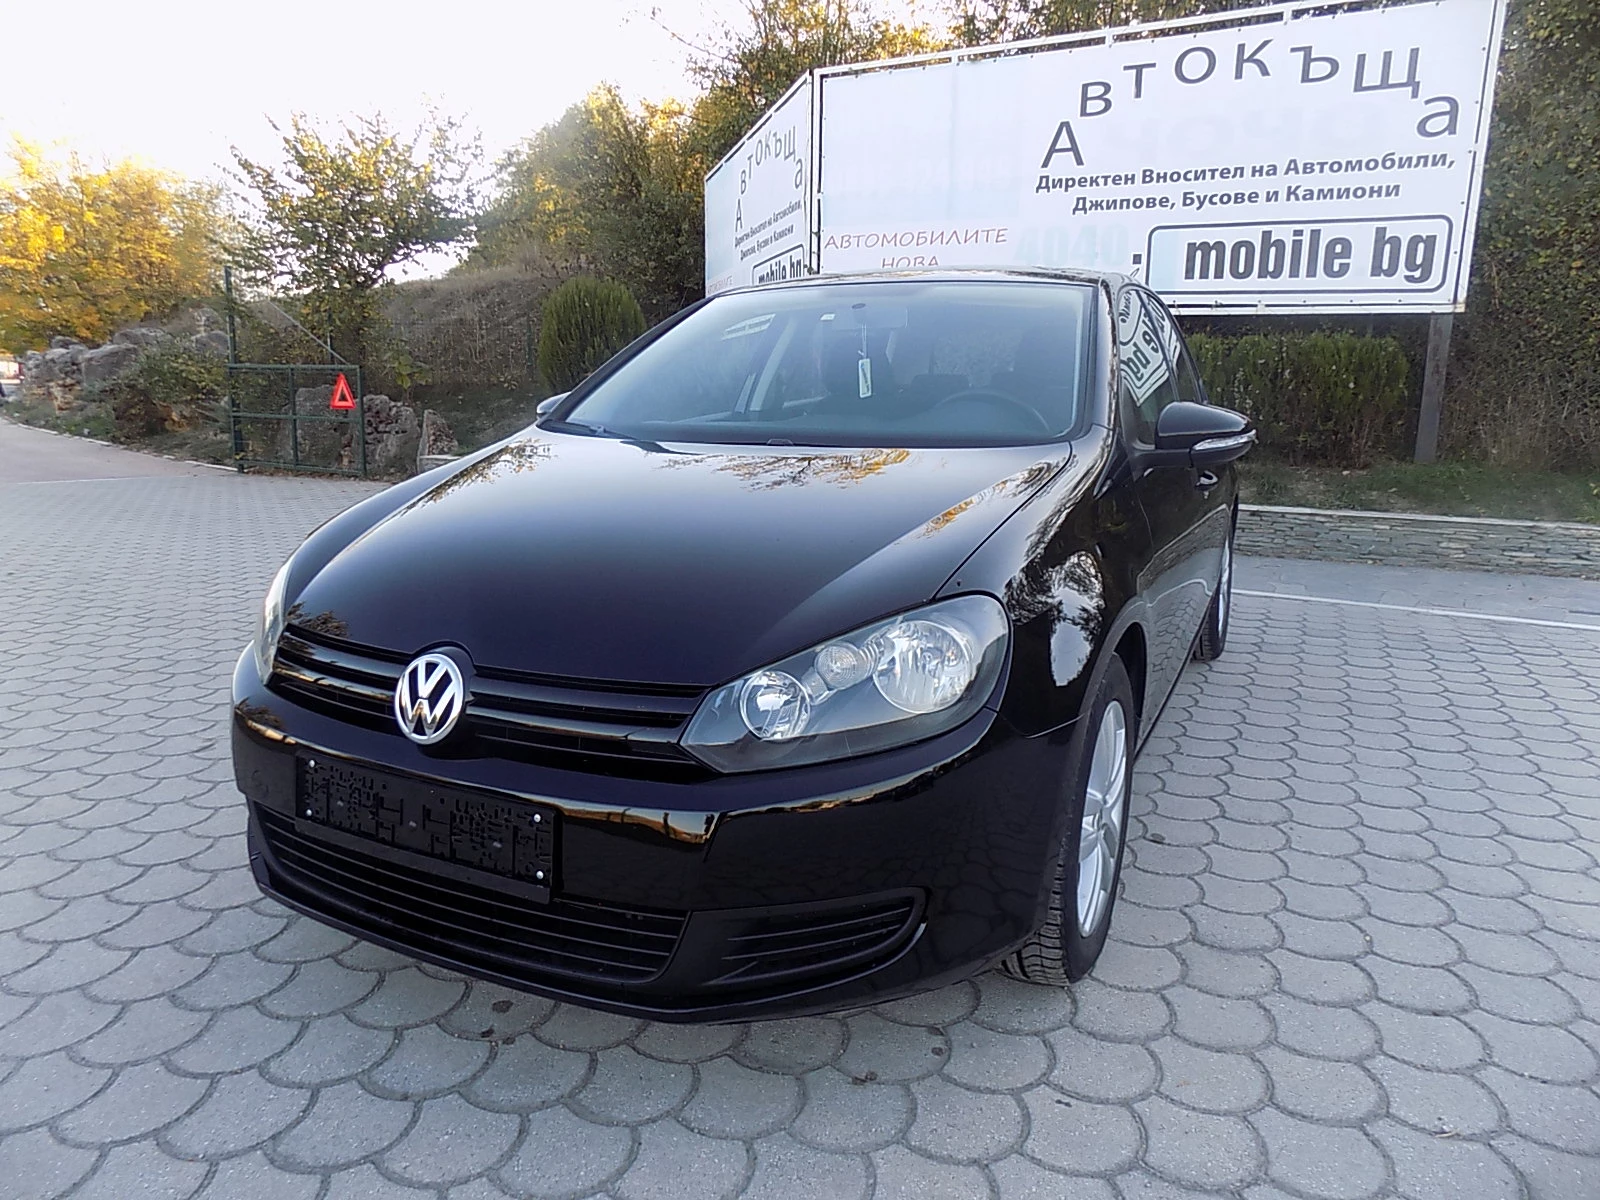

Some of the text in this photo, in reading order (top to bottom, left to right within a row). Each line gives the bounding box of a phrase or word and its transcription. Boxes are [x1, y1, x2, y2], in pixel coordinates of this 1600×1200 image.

[1035, 173, 1136, 193] Директен
[1141, 165, 1245, 185] Вносител
[1250, 163, 1278, 178] на
[1283, 152, 1456, 176] Автомобили,
[1072, 183, 1402, 215] Джипове, Бусове и Камиони
[824, 227, 1009, 250] АВТОМОБИЛИТЕ
[1184, 226, 1438, 284] mobile bg
